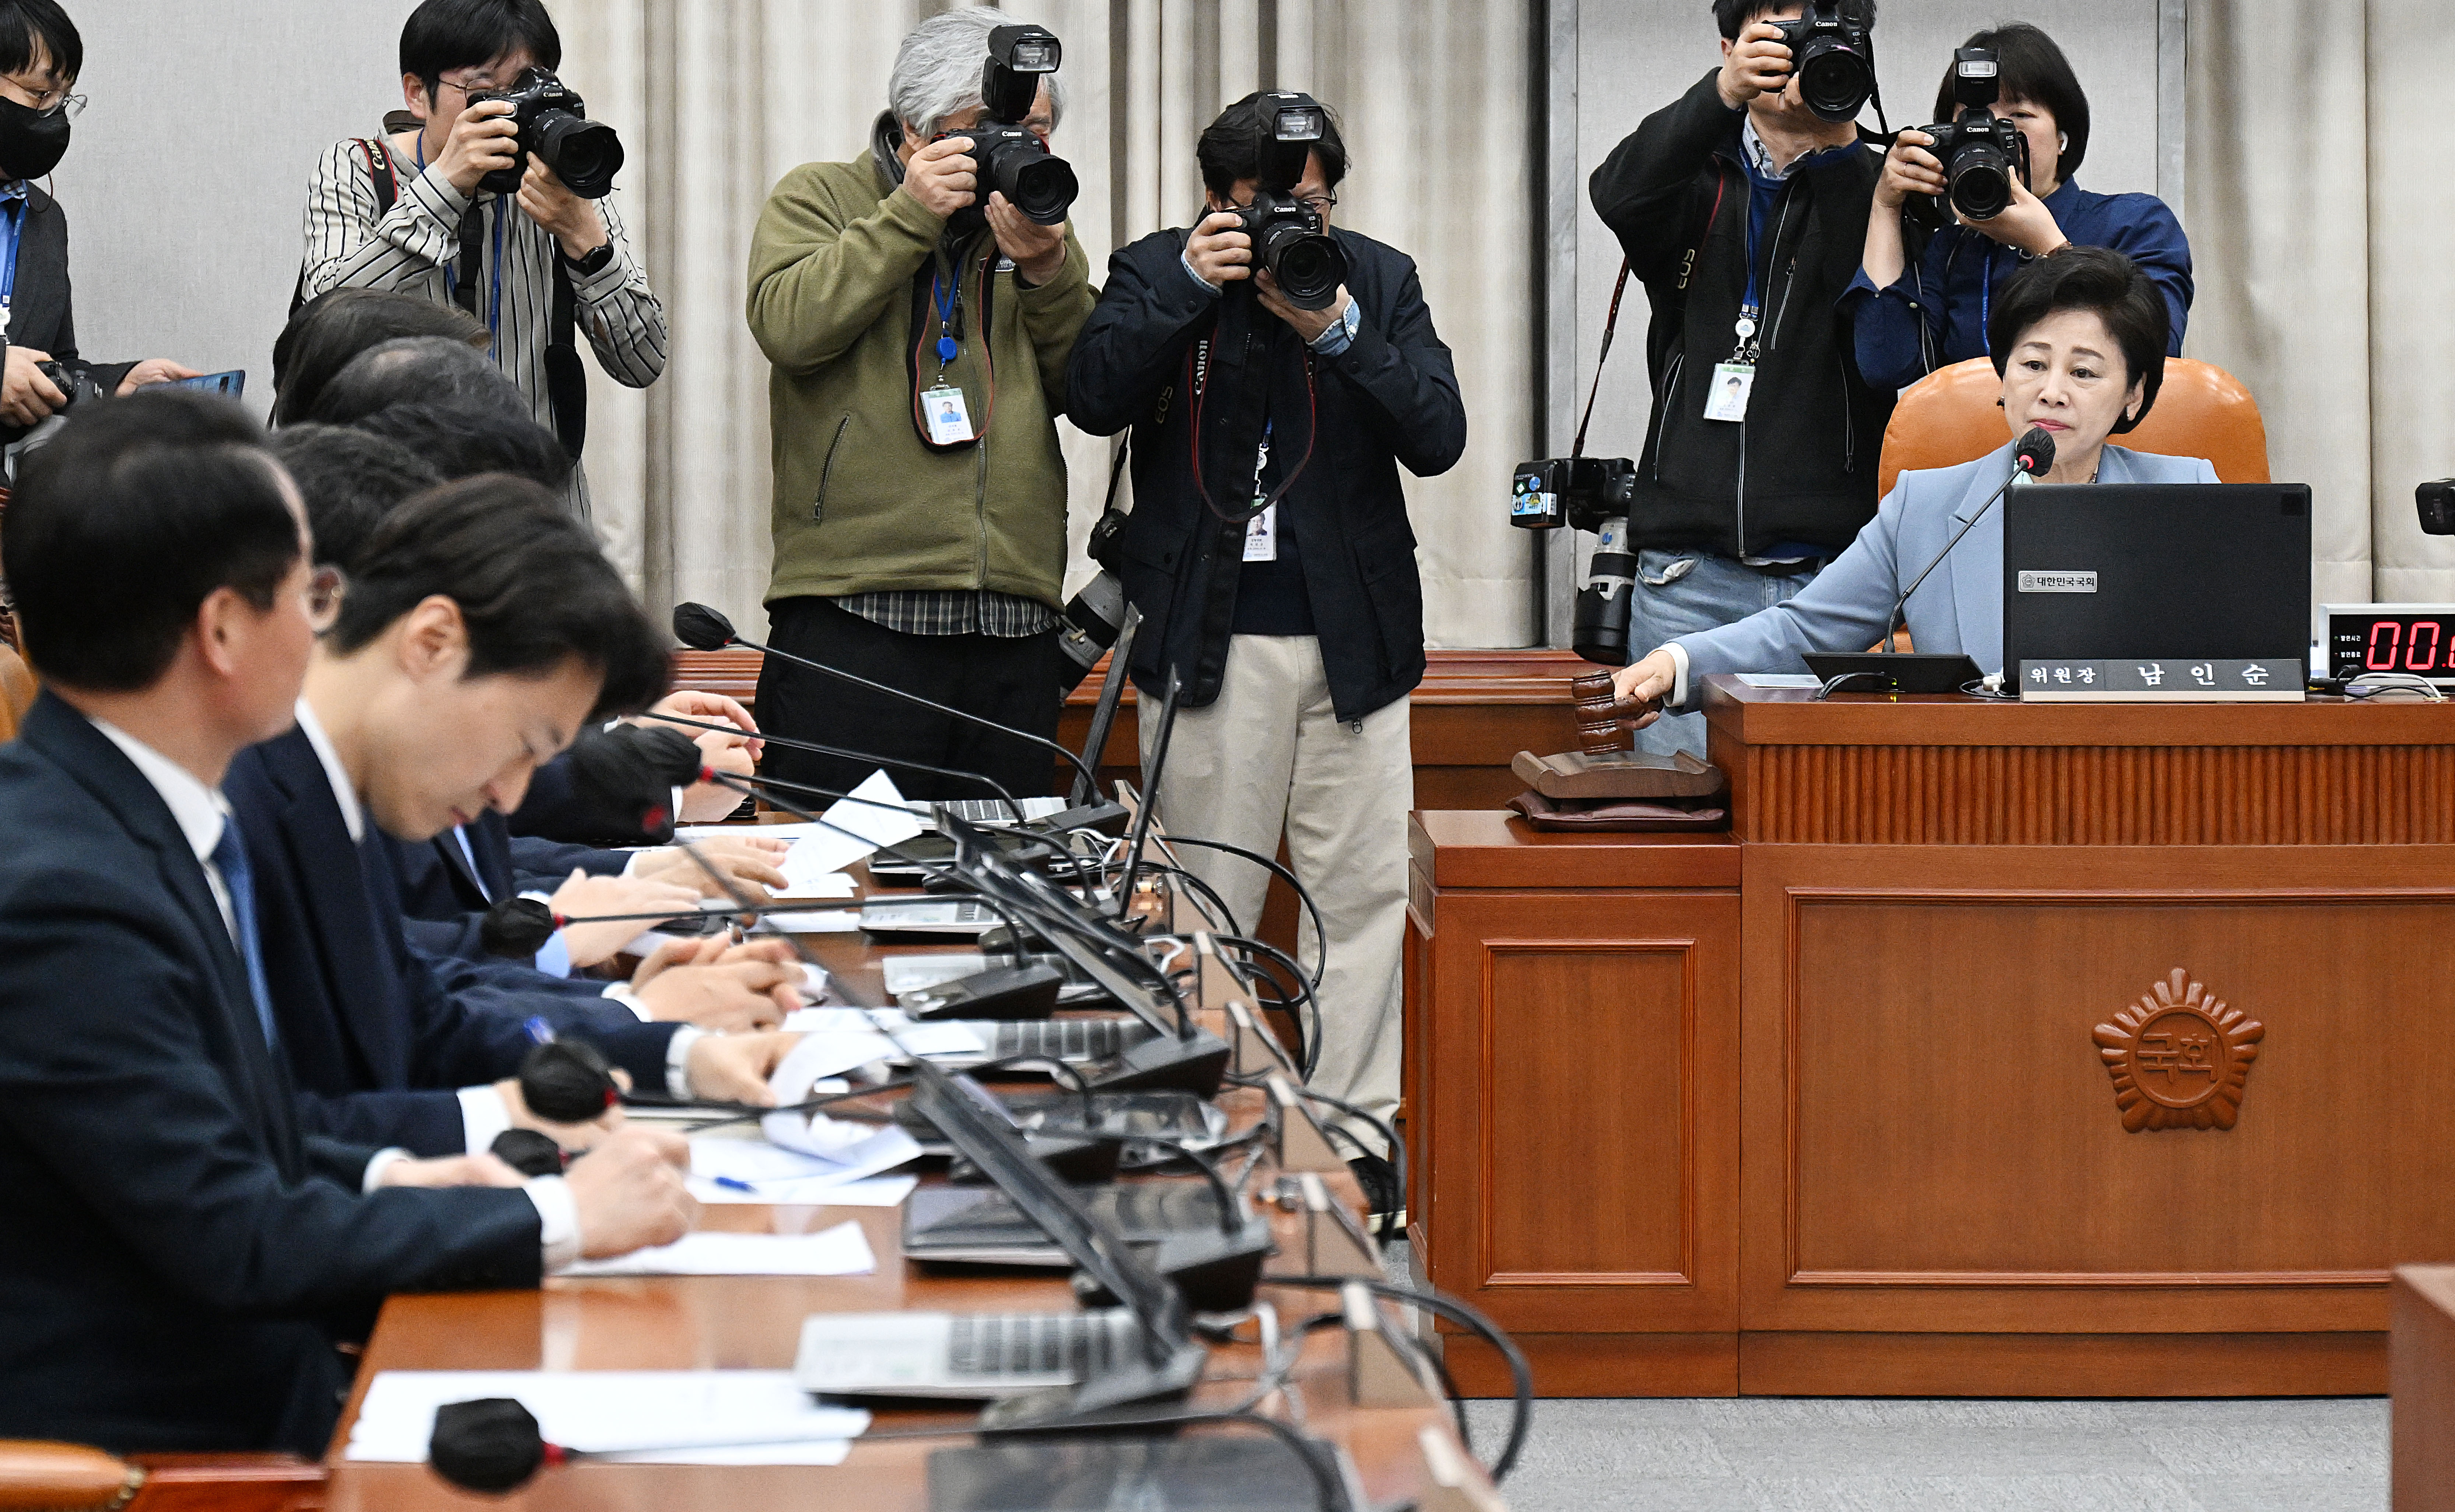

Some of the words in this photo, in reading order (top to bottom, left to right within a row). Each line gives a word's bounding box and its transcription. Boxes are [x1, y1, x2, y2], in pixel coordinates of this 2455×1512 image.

[1195, 340, 1208, 395] Canon
[1155, 382, 1173, 424] EOS
[2030, 667, 2096, 684] 위원장
[2137, 1032, 2218, 1084] 국회
